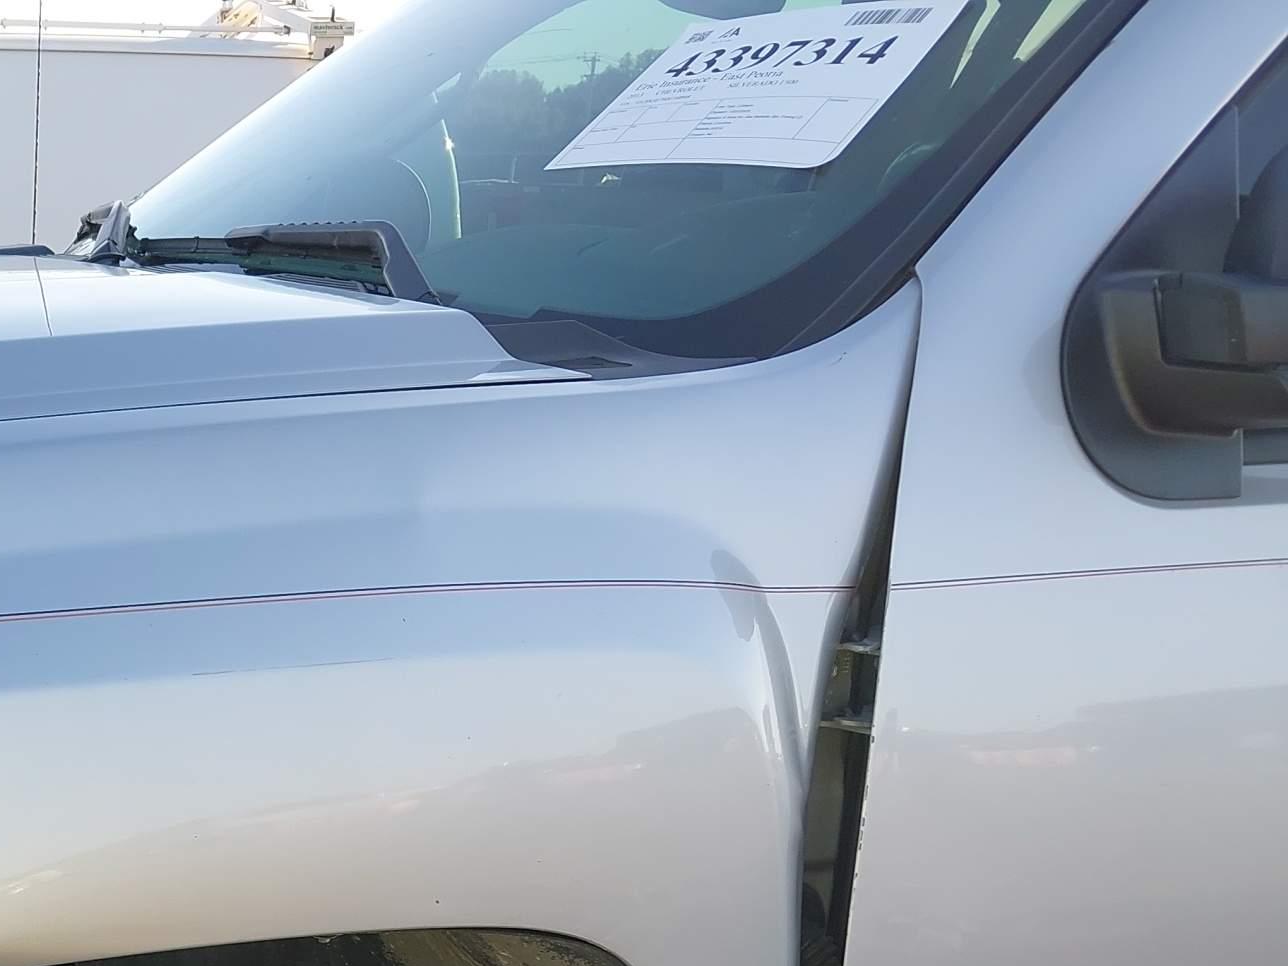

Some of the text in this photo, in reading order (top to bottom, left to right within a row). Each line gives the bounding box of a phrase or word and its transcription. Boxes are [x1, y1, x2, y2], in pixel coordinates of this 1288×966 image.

[665, 35, 900, 78] 43397314
[660, 77, 711, 88] Insurance
[720, 72, 746, 81] East
[747, 70, 783, 79] Peoria
